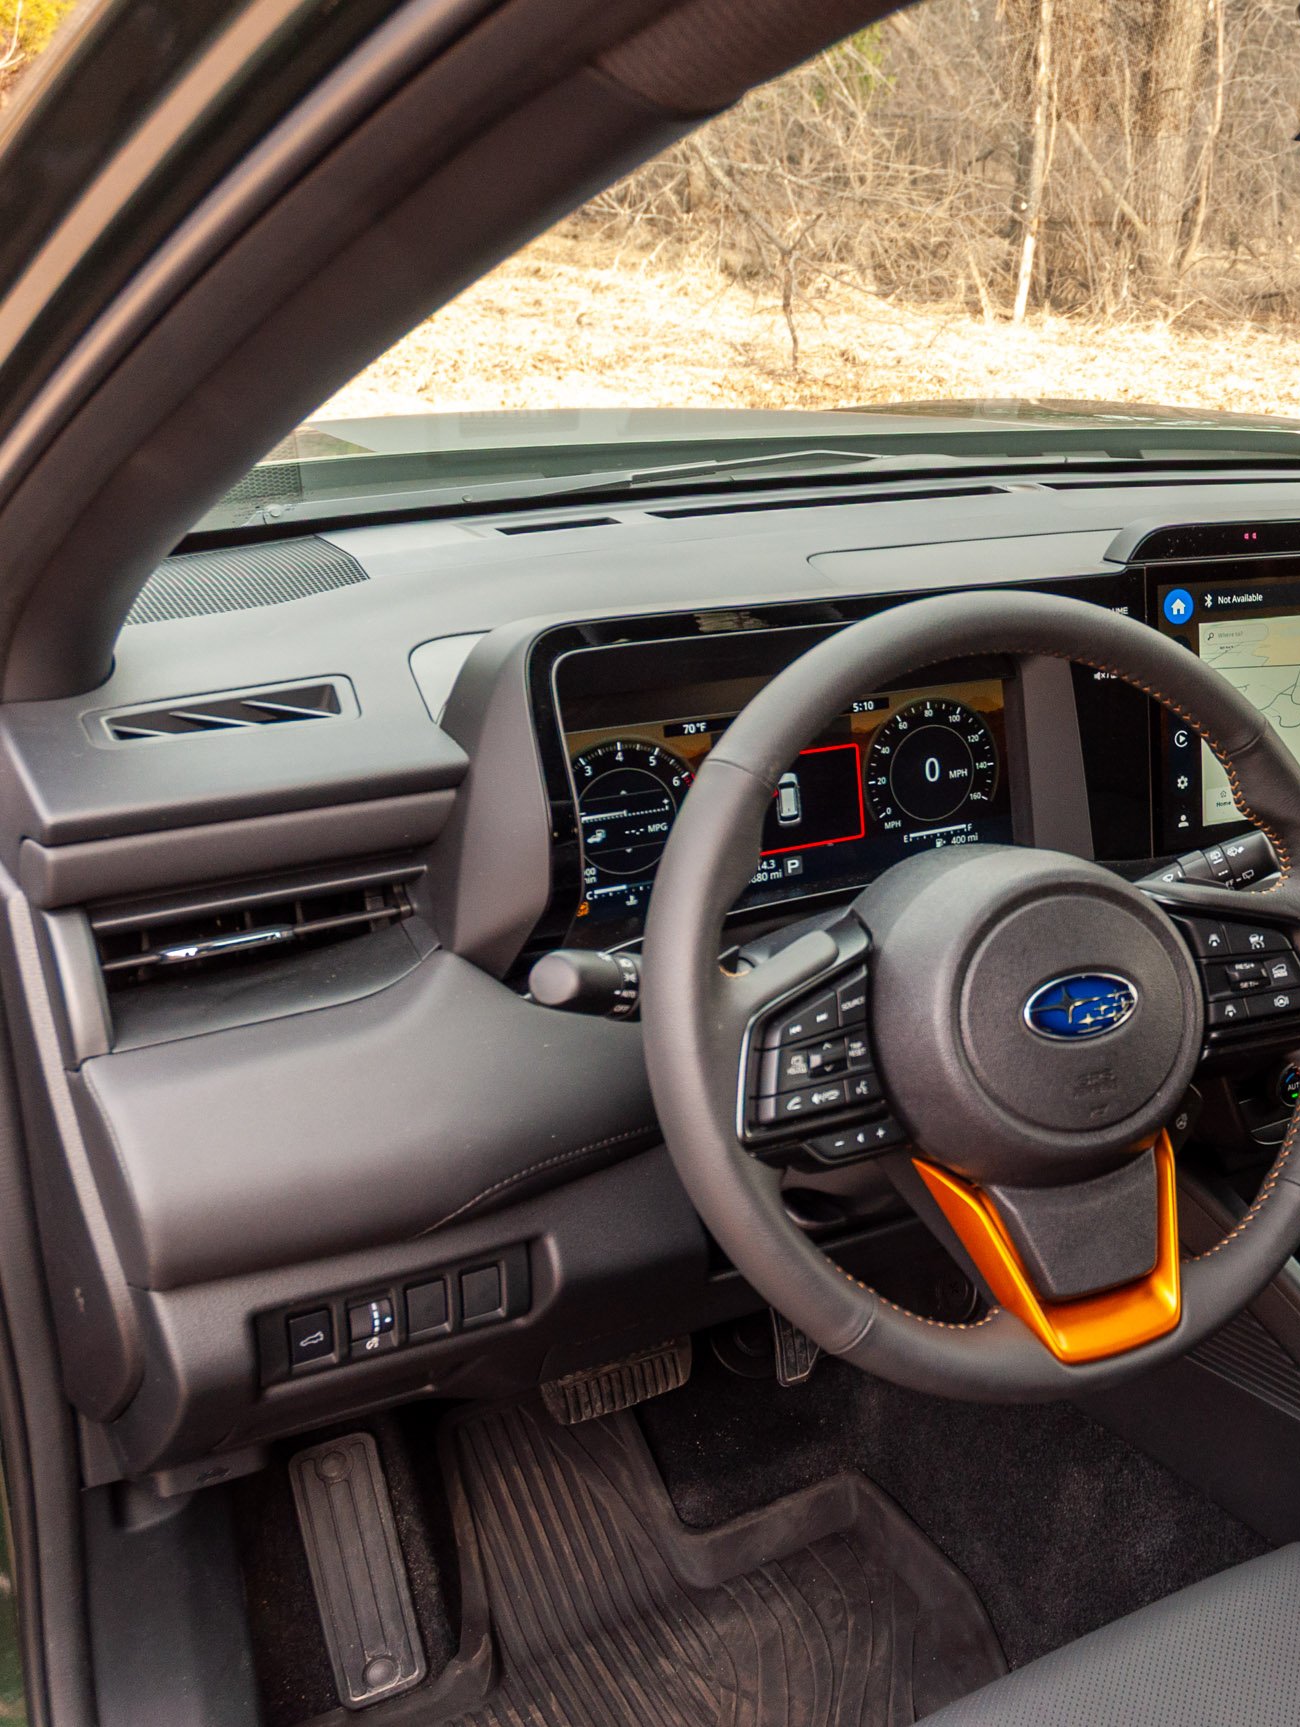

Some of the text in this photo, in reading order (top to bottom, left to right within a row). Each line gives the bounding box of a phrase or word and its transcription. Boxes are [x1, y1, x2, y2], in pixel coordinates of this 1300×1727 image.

[1218, 592, 1263, 604] Not Available
[852, 700, 874, 712] 5:10
[948, 714, 961, 723] 100
[898, 722, 908, 730] 60
[968, 734, 980, 742] 120
[880, 746, 890, 754] 40
[615, 752, 624, 762] 4
[648, 756, 657, 766] 5
[925, 757, 968, 782] 0 MPH
[976, 761, 987, 770] 140
[584, 766, 592, 776] 3
[672, 776, 680, 786] 6
[877, 777, 886, 785] 20
[970, 792, 982, 800] 160
[1216, 800, 1232, 808] Home
[886, 807, 892, 815] 0
[648, 822, 668, 833] MPG
[884, 820, 902, 830] MPH
[967, 823, 972, 832] F
[904, 835, 908, 843] E
[951, 832, 978, 844] 400 mi
[786, 860, 800, 874] P
[770, 868, 782, 880] mi
[586, 891, 594, 900] C
[1287, 1082, 1300, 1092] AUT
